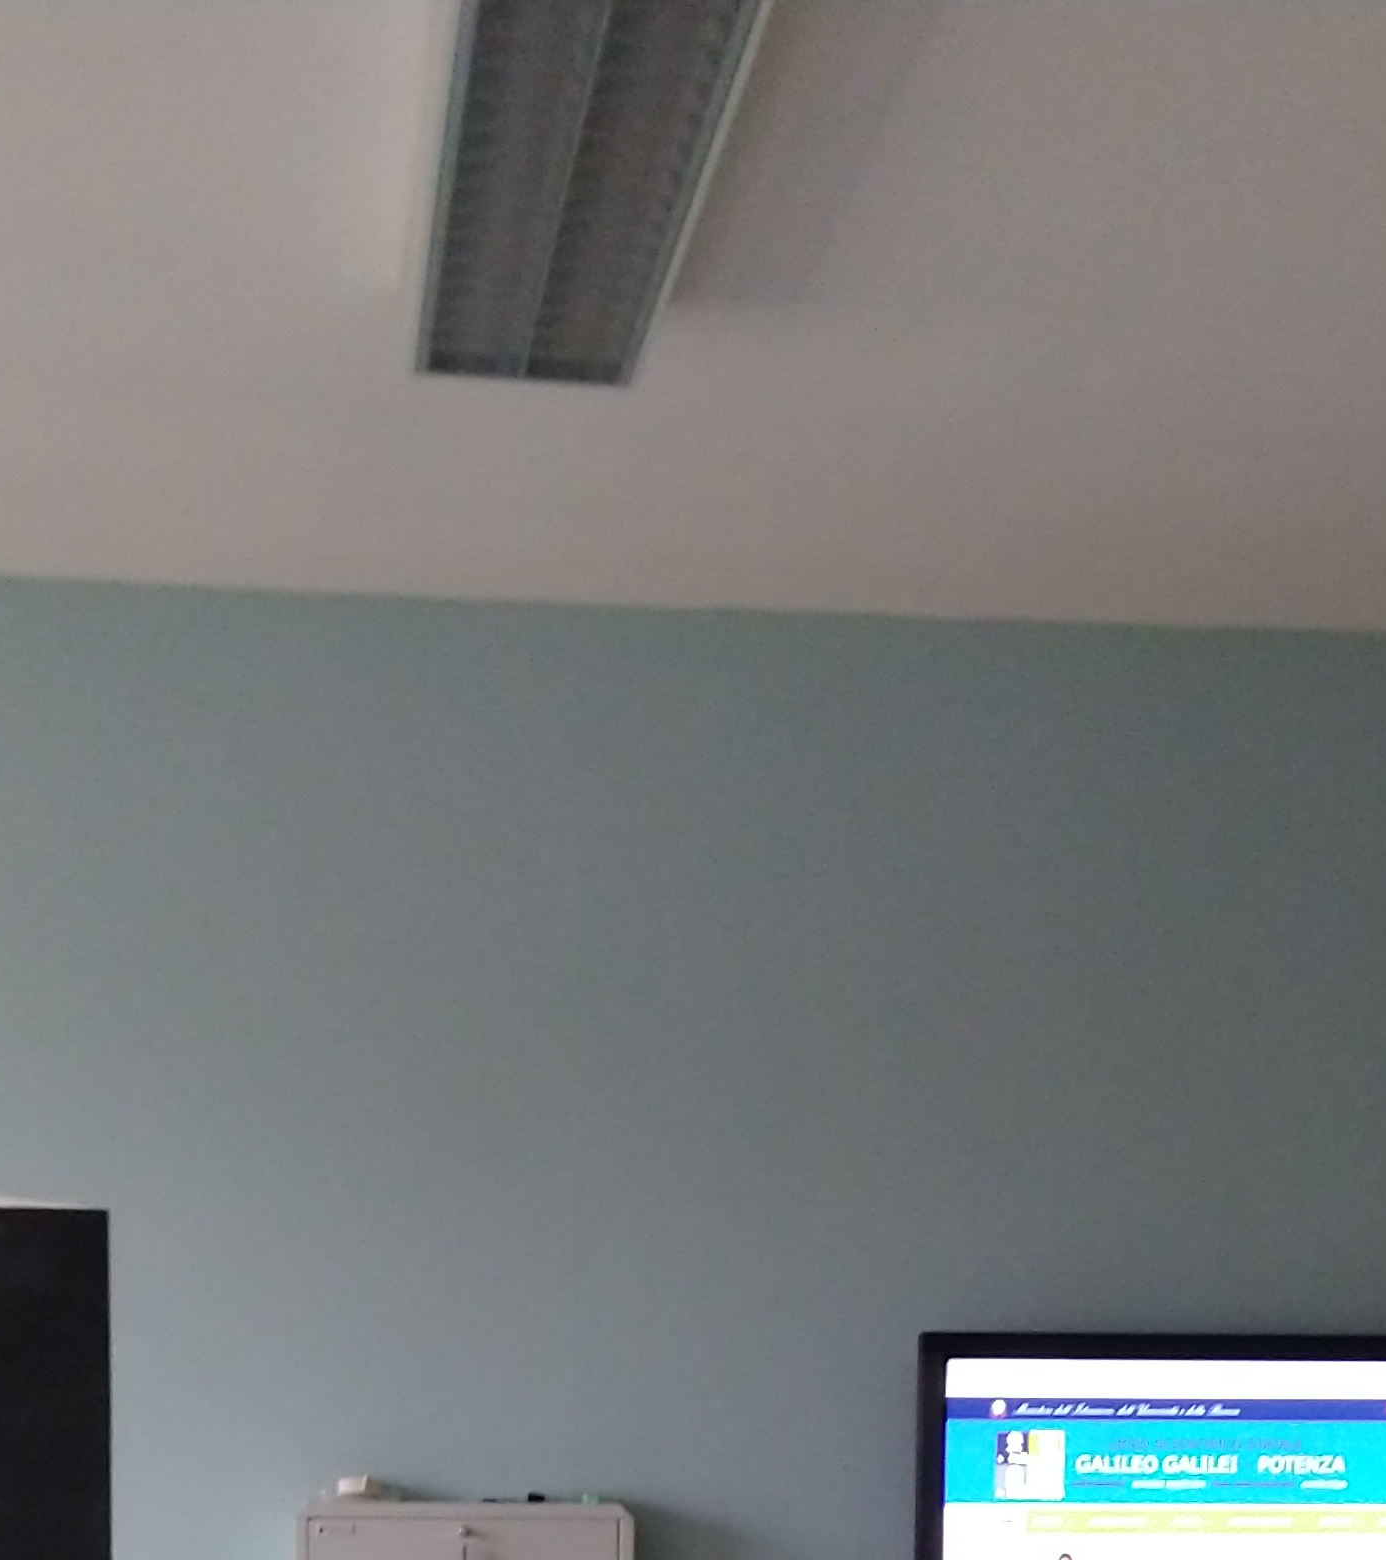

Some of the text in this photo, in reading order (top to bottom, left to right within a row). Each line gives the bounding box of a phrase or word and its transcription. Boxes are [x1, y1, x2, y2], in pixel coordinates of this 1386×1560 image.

[1075, 1454, 1346, 1474] GALILEO GALILEI POTENZA
